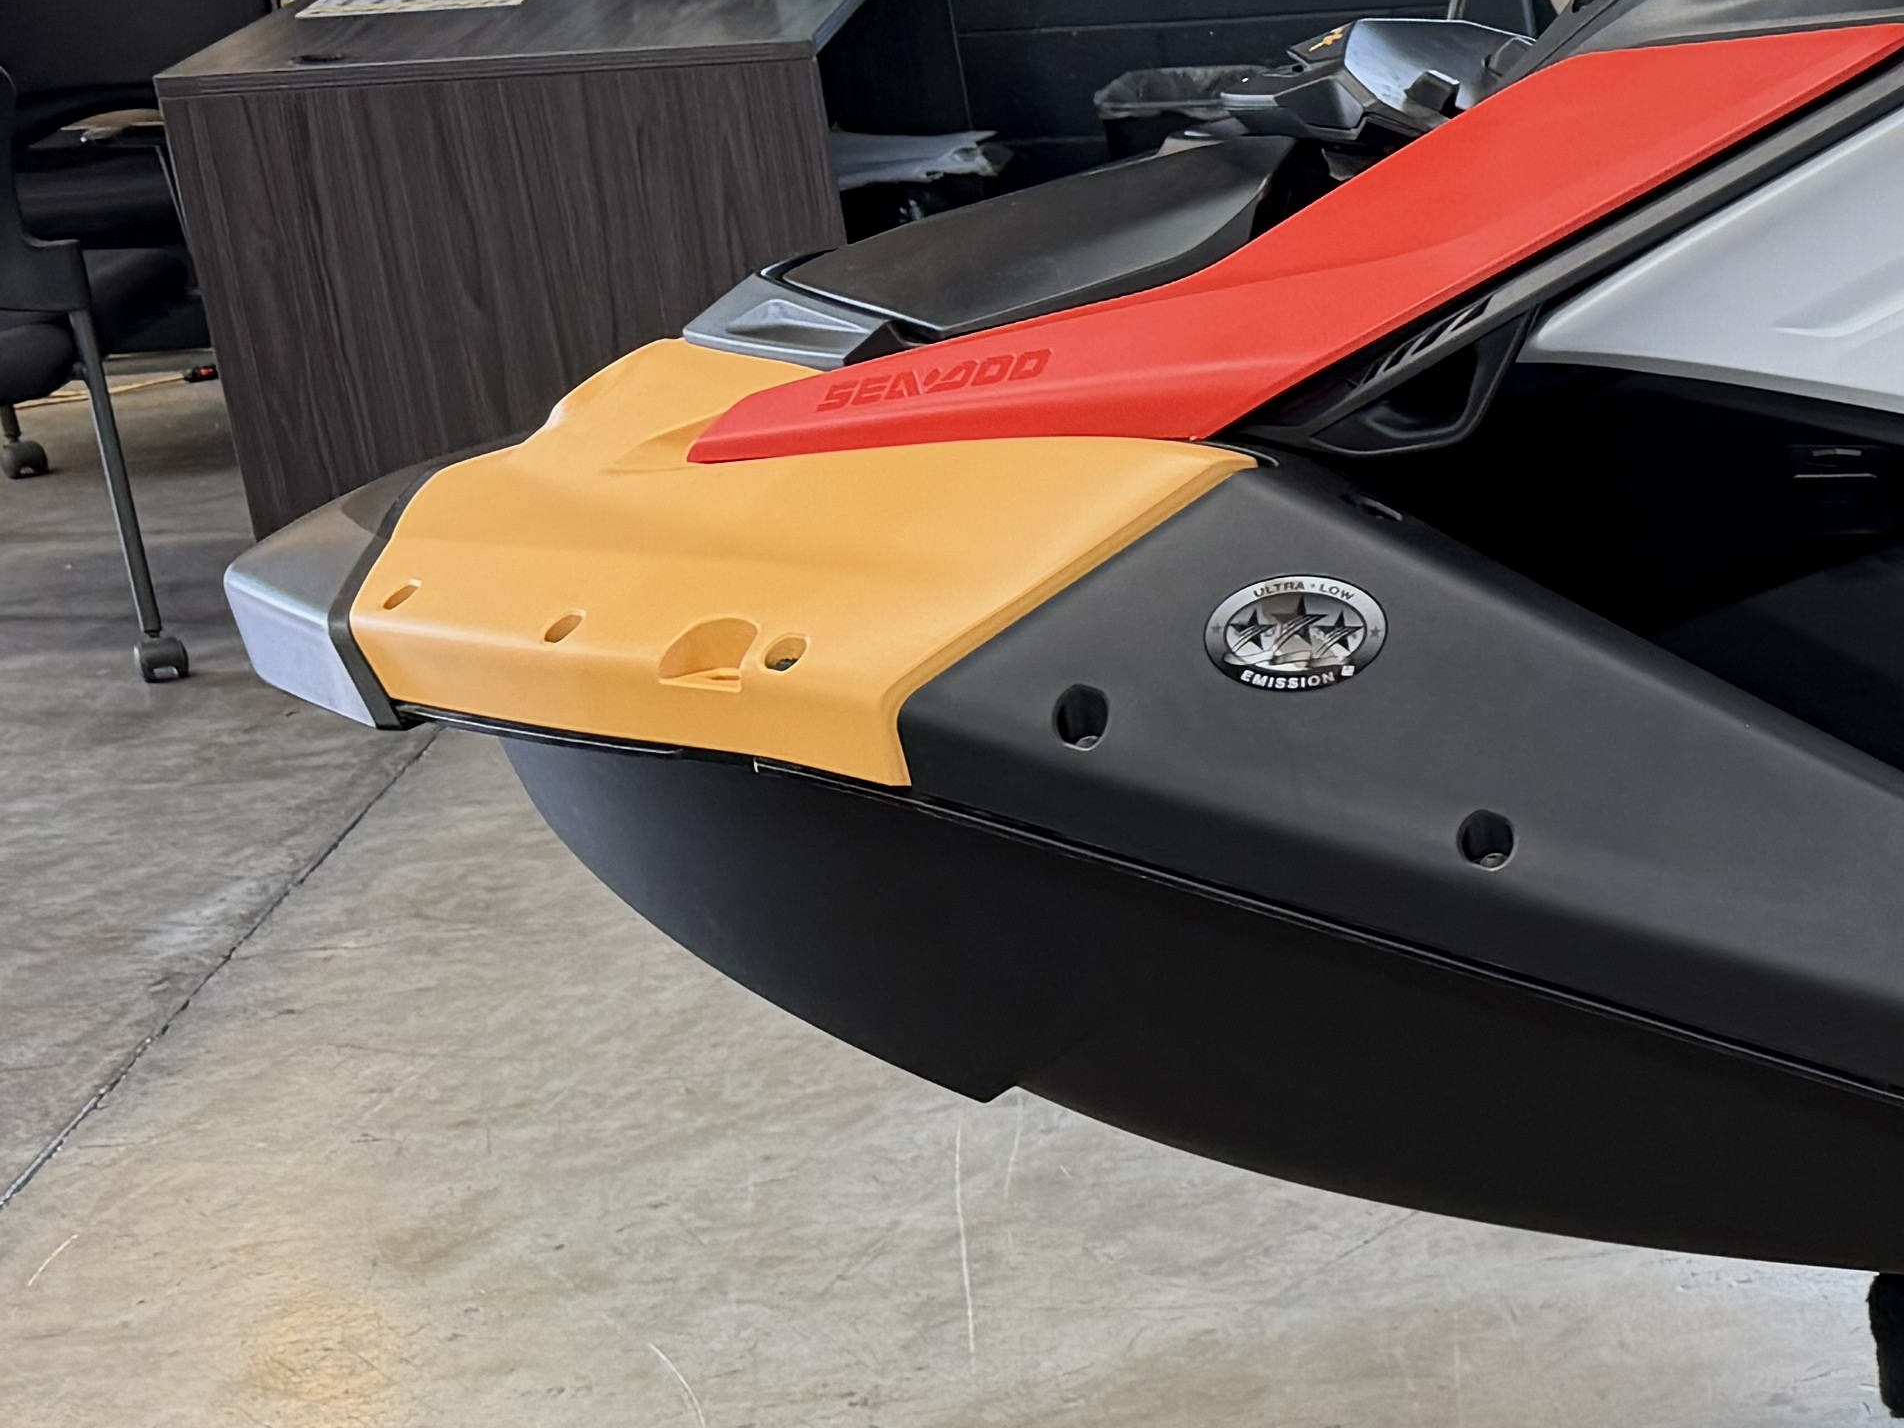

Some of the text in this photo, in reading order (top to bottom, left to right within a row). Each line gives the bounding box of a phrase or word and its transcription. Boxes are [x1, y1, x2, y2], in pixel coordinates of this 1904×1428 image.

[1253, 581, 1354, 600] ULTRA LOW
[1240, 669, 1335, 688] EMISSION
